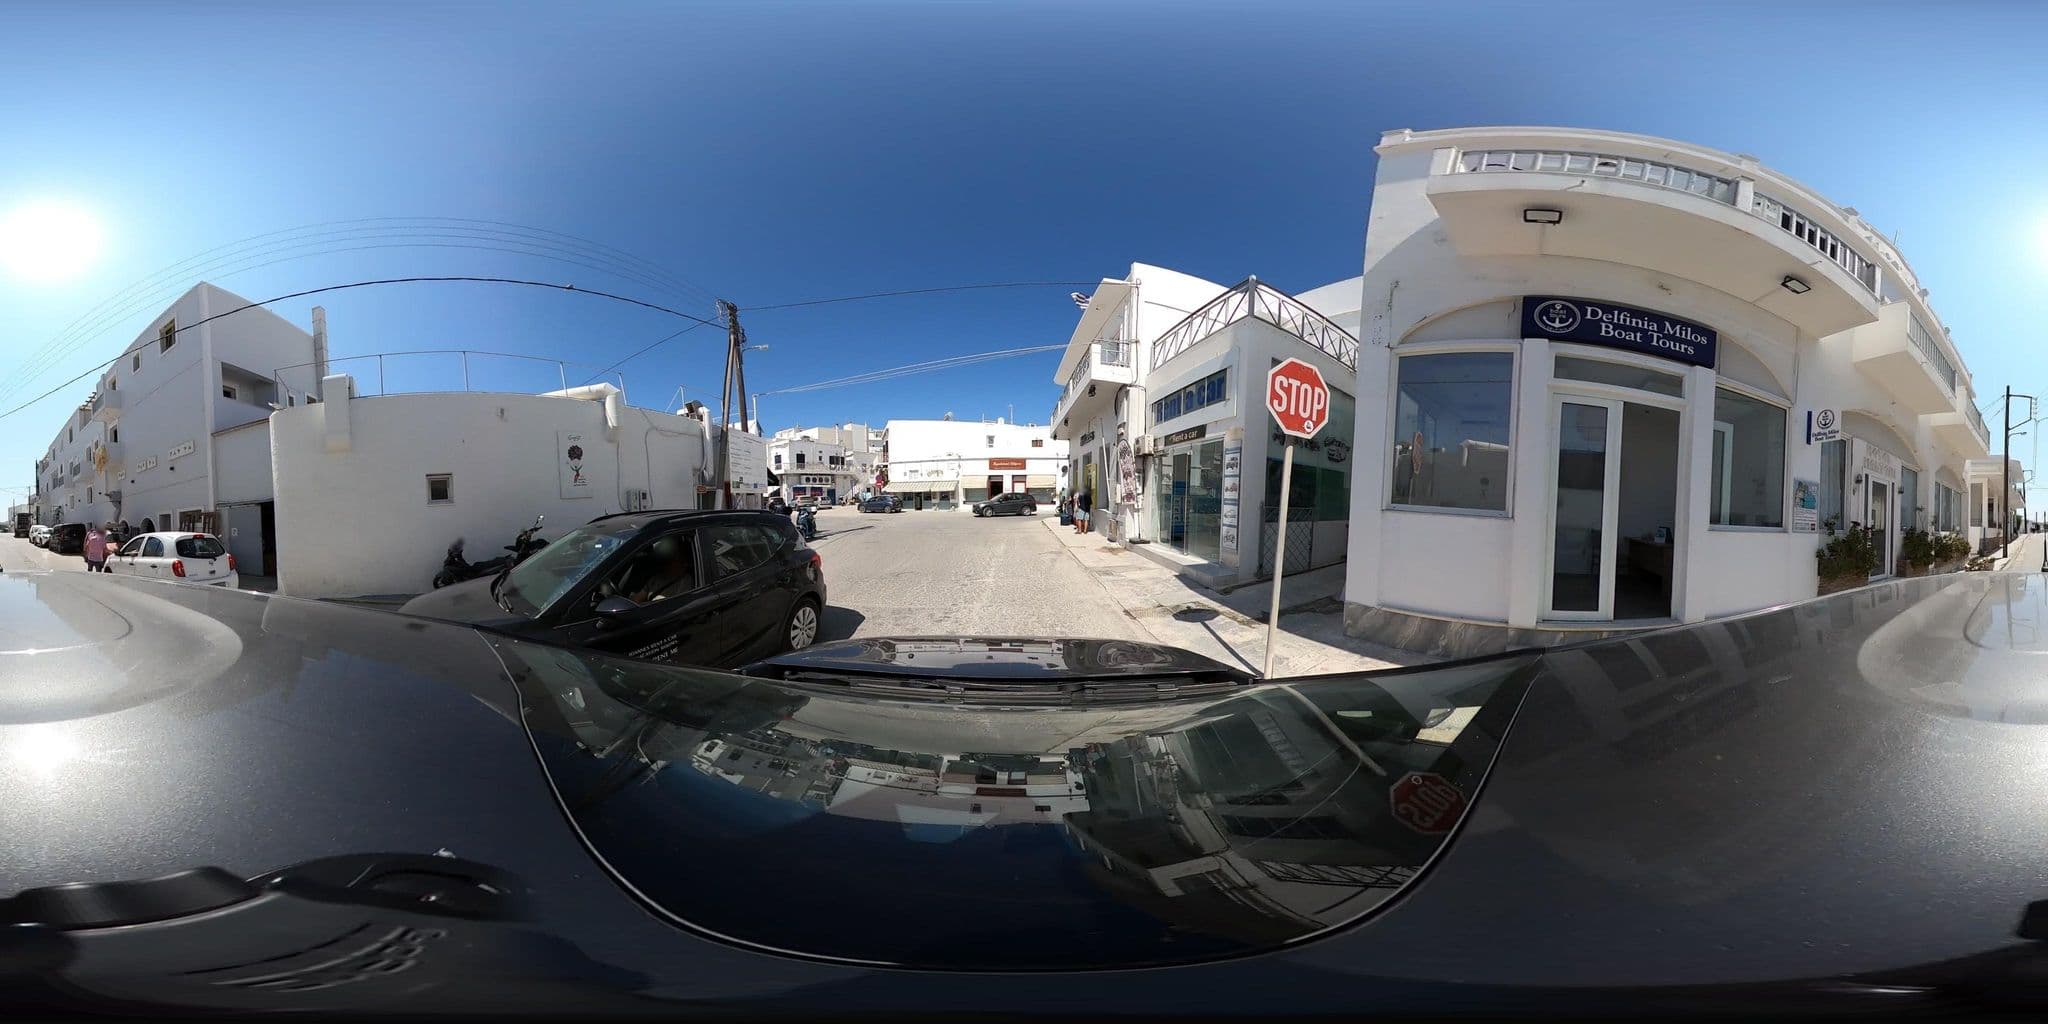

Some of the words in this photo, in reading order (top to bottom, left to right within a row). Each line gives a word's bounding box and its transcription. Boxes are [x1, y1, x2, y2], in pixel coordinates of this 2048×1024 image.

[1585, 305, 1658, 331] Delfinia
[1663, 321, 1708, 345] Milos
[1600, 322, 1643, 343] Boat
[1648, 331, 1695, 355] Tours
[1157, 394, 1182, 423] Rent
[1185, 390, 1194, 410] a
[1196, 375, 1225, 406] car
[1273, 375, 1325, 421] STOP
[1188, 431, 1198, 439] car
